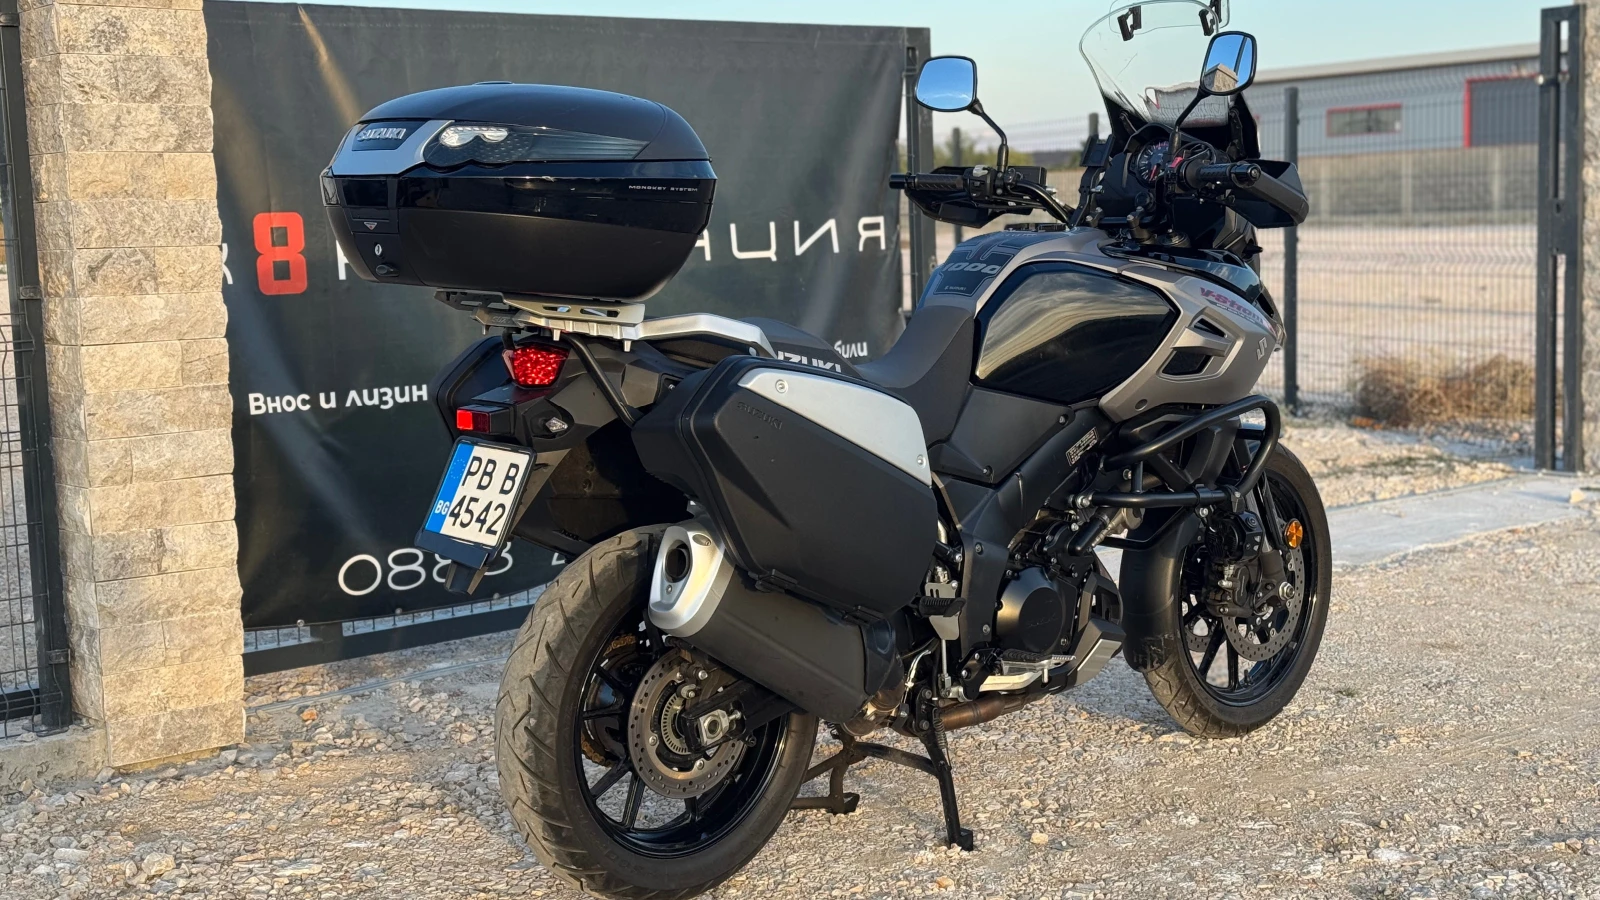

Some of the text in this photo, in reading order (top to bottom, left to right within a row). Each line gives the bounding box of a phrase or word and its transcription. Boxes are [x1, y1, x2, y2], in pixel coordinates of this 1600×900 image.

[356, 128, 406, 141] SUZUKI
[253, 211, 308, 296] 8
[942, 262, 1002, 275] 1000
[248, 339, 868, 415] Внос и лизин били
[461, 455, 497, 491] PB
[434, 500, 450, 516] BG
[448, 495, 506, 536] 4542
